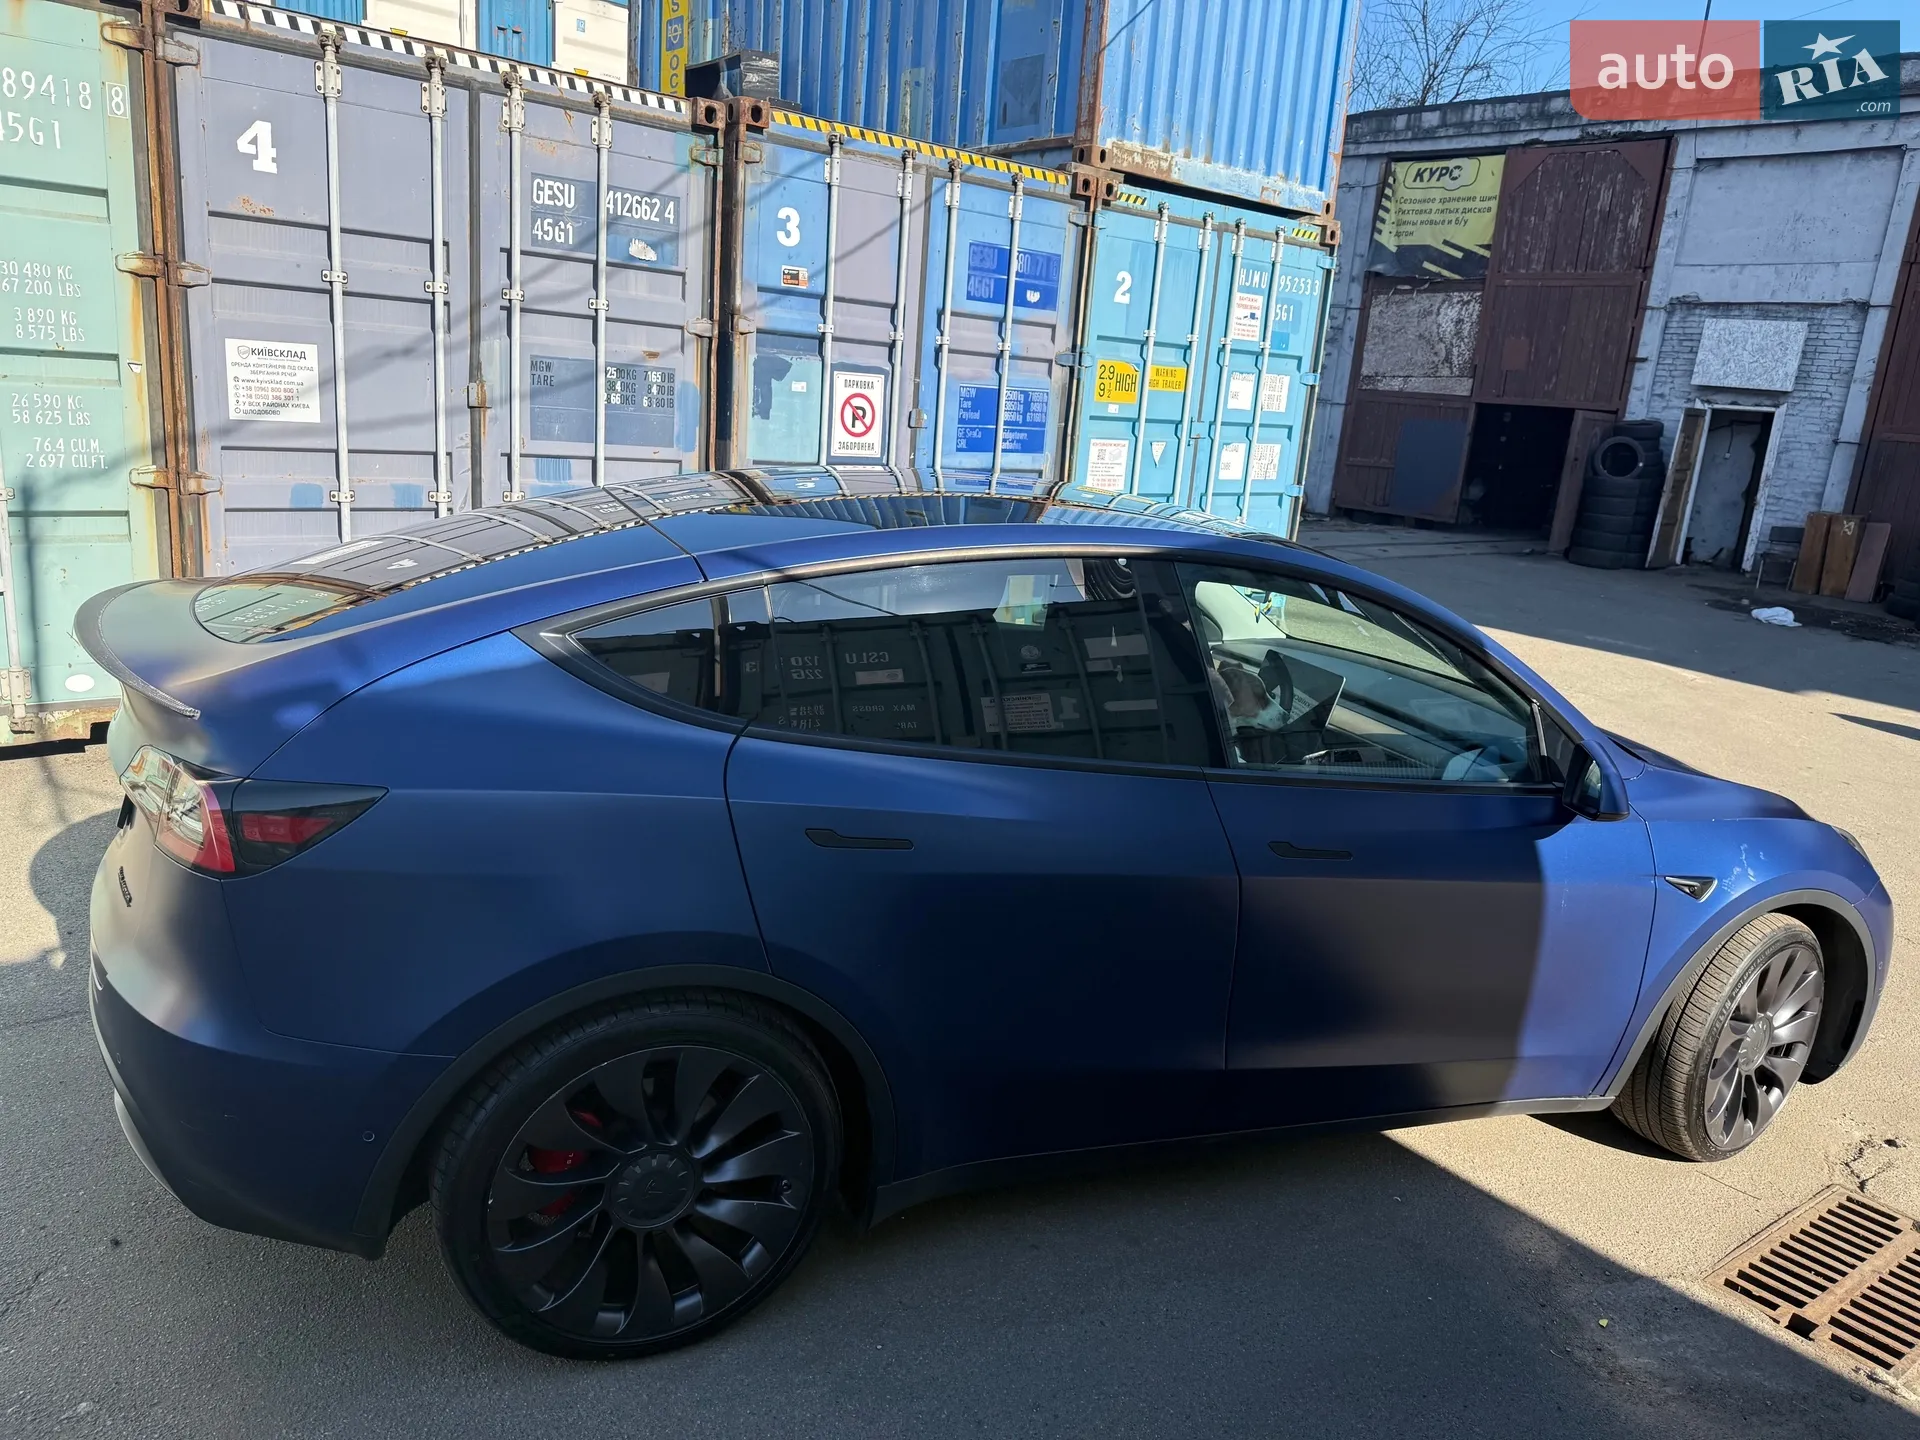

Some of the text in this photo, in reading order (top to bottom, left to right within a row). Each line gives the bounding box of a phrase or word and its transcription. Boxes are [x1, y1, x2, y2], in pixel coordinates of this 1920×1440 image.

[111, 86, 124, 115] 8
[0, 109, 61, 149] 5G1
[237, 120, 278, 174] 4
[1412, 165, 1463, 183] КУРС
[532, 178, 675, 224] GESU 412662 4
[1400, 194, 1497, 205] Сезонное хранение шин
[1398, 206, 1492, 216] Рихтовка литых дисков
[776, 207, 800, 247] 3
[1419, 218, 1446, 226] новые
[1455, 216, 1469, 227] б/у
[532, 218, 573, 245] 45G1
[23, 262, 51, 278] 480
[57, 265, 73, 280] KG
[1239, 268, 1268, 289] HJMU
[2, 278, 81, 297] 67 200 LBS
[1113, 270, 1132, 305] 2
[14, 307, 77, 325] 3 890 KG
[1274, 304, 1294, 322] 5G1
[16, 324, 85, 342] 8 575 LBS
[251, 347, 306, 360] КИЇВСКЛАД
[531, 374, 555, 387] TARE
[1098, 364, 1137, 393] 2.9 HIGH
[1155, 367, 1177, 378] WARNING
[844, 379, 874, 390] ПАРКОВКА
[960, 387, 976, 398] MGW
[1161, 380, 1182, 390] TRAILER
[12, 393, 83, 410] 26 590 KG
[960, 398, 972, 409] Tare
[12, 409, 91, 426] 58 625 LBS
[852, 406, 866, 428] P
[959, 409, 980, 420] Payload
[33, 437, 65, 452] 76.4
[1002, 430, 1028, 442] ridgetown,
[838, 442, 874, 451] ЗАБОРОНЕНА
[1001, 441, 1022, 451] arbados
[26, 454, 34, 468] 2
[39, 454, 65, 468] 697
[1732, 979, 1744, 997] PILOT
[1743, 963, 1757, 980] SPORT
